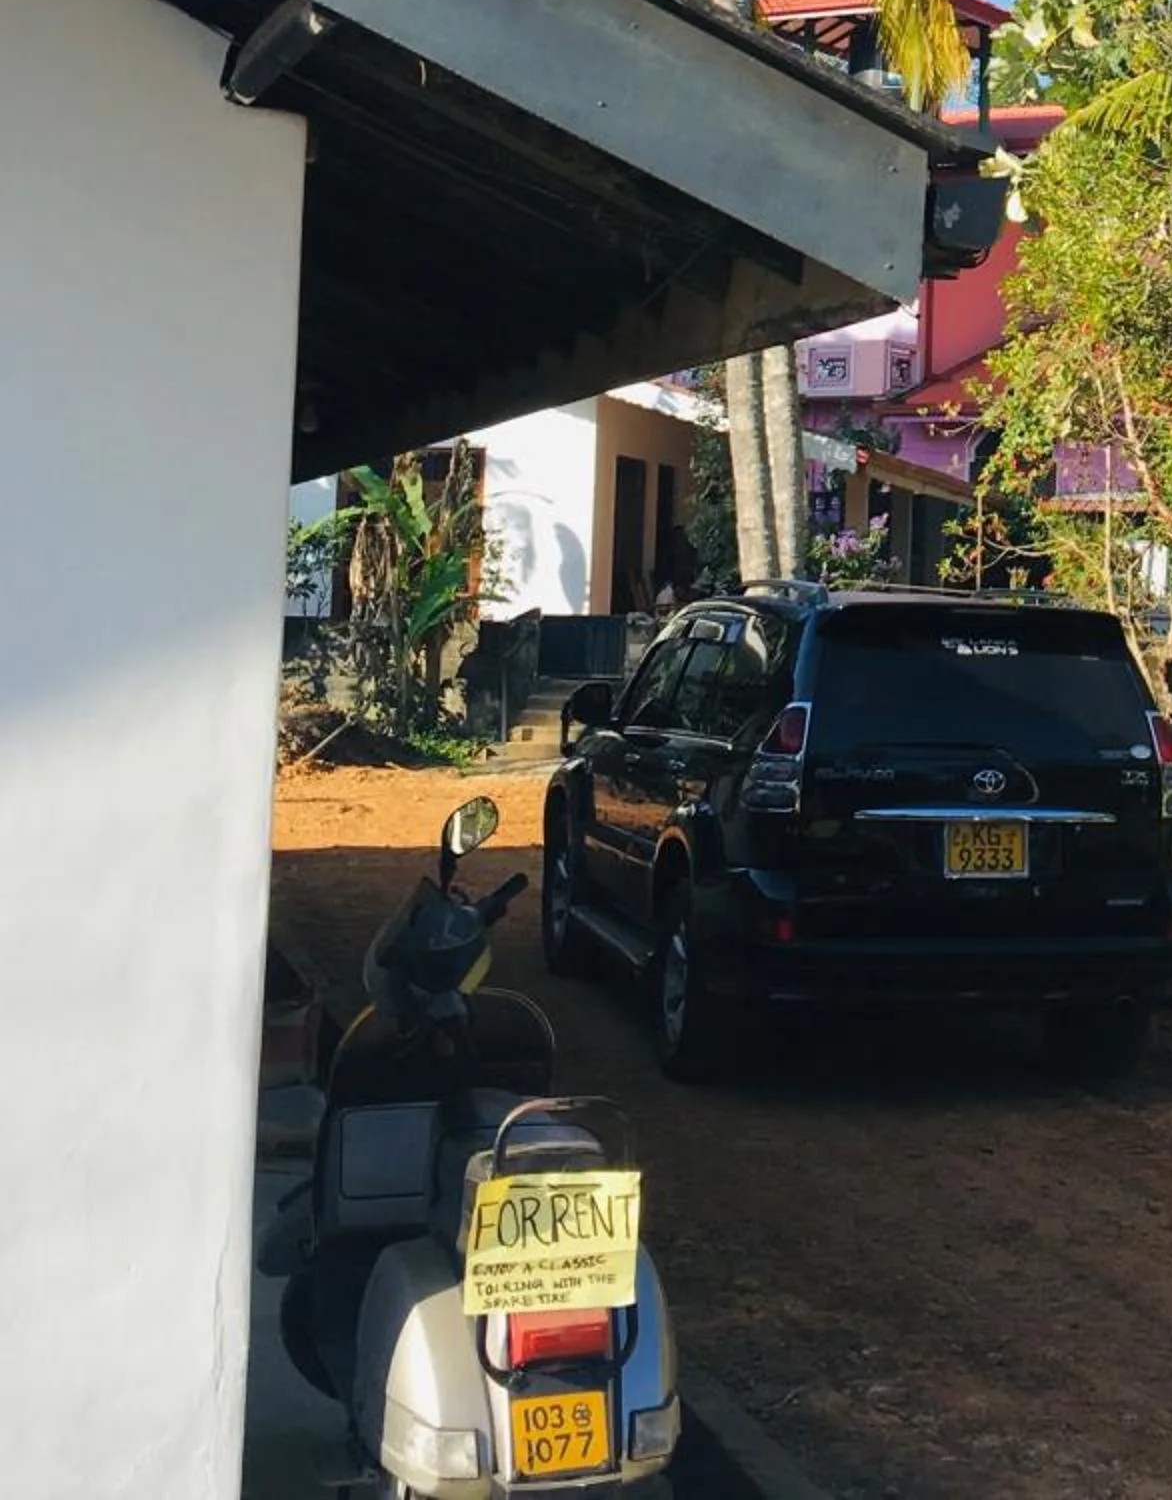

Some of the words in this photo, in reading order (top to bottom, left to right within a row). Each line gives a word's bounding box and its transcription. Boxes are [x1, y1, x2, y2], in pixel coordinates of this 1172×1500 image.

[973, 823, 1001, 846] KG
[959, 847, 1014, 870] 9333
[474, 1197, 551, 1250] FOR
[551, 1192, 636, 1243] RENT
[538, 1254, 607, 1271] CLASSIC
[553, 1276, 582, 1289] WITH
[587, 1272, 617, 1285] THE
[523, 1404, 565, 1433] 103
[525, 1430, 594, 1471] 1077
